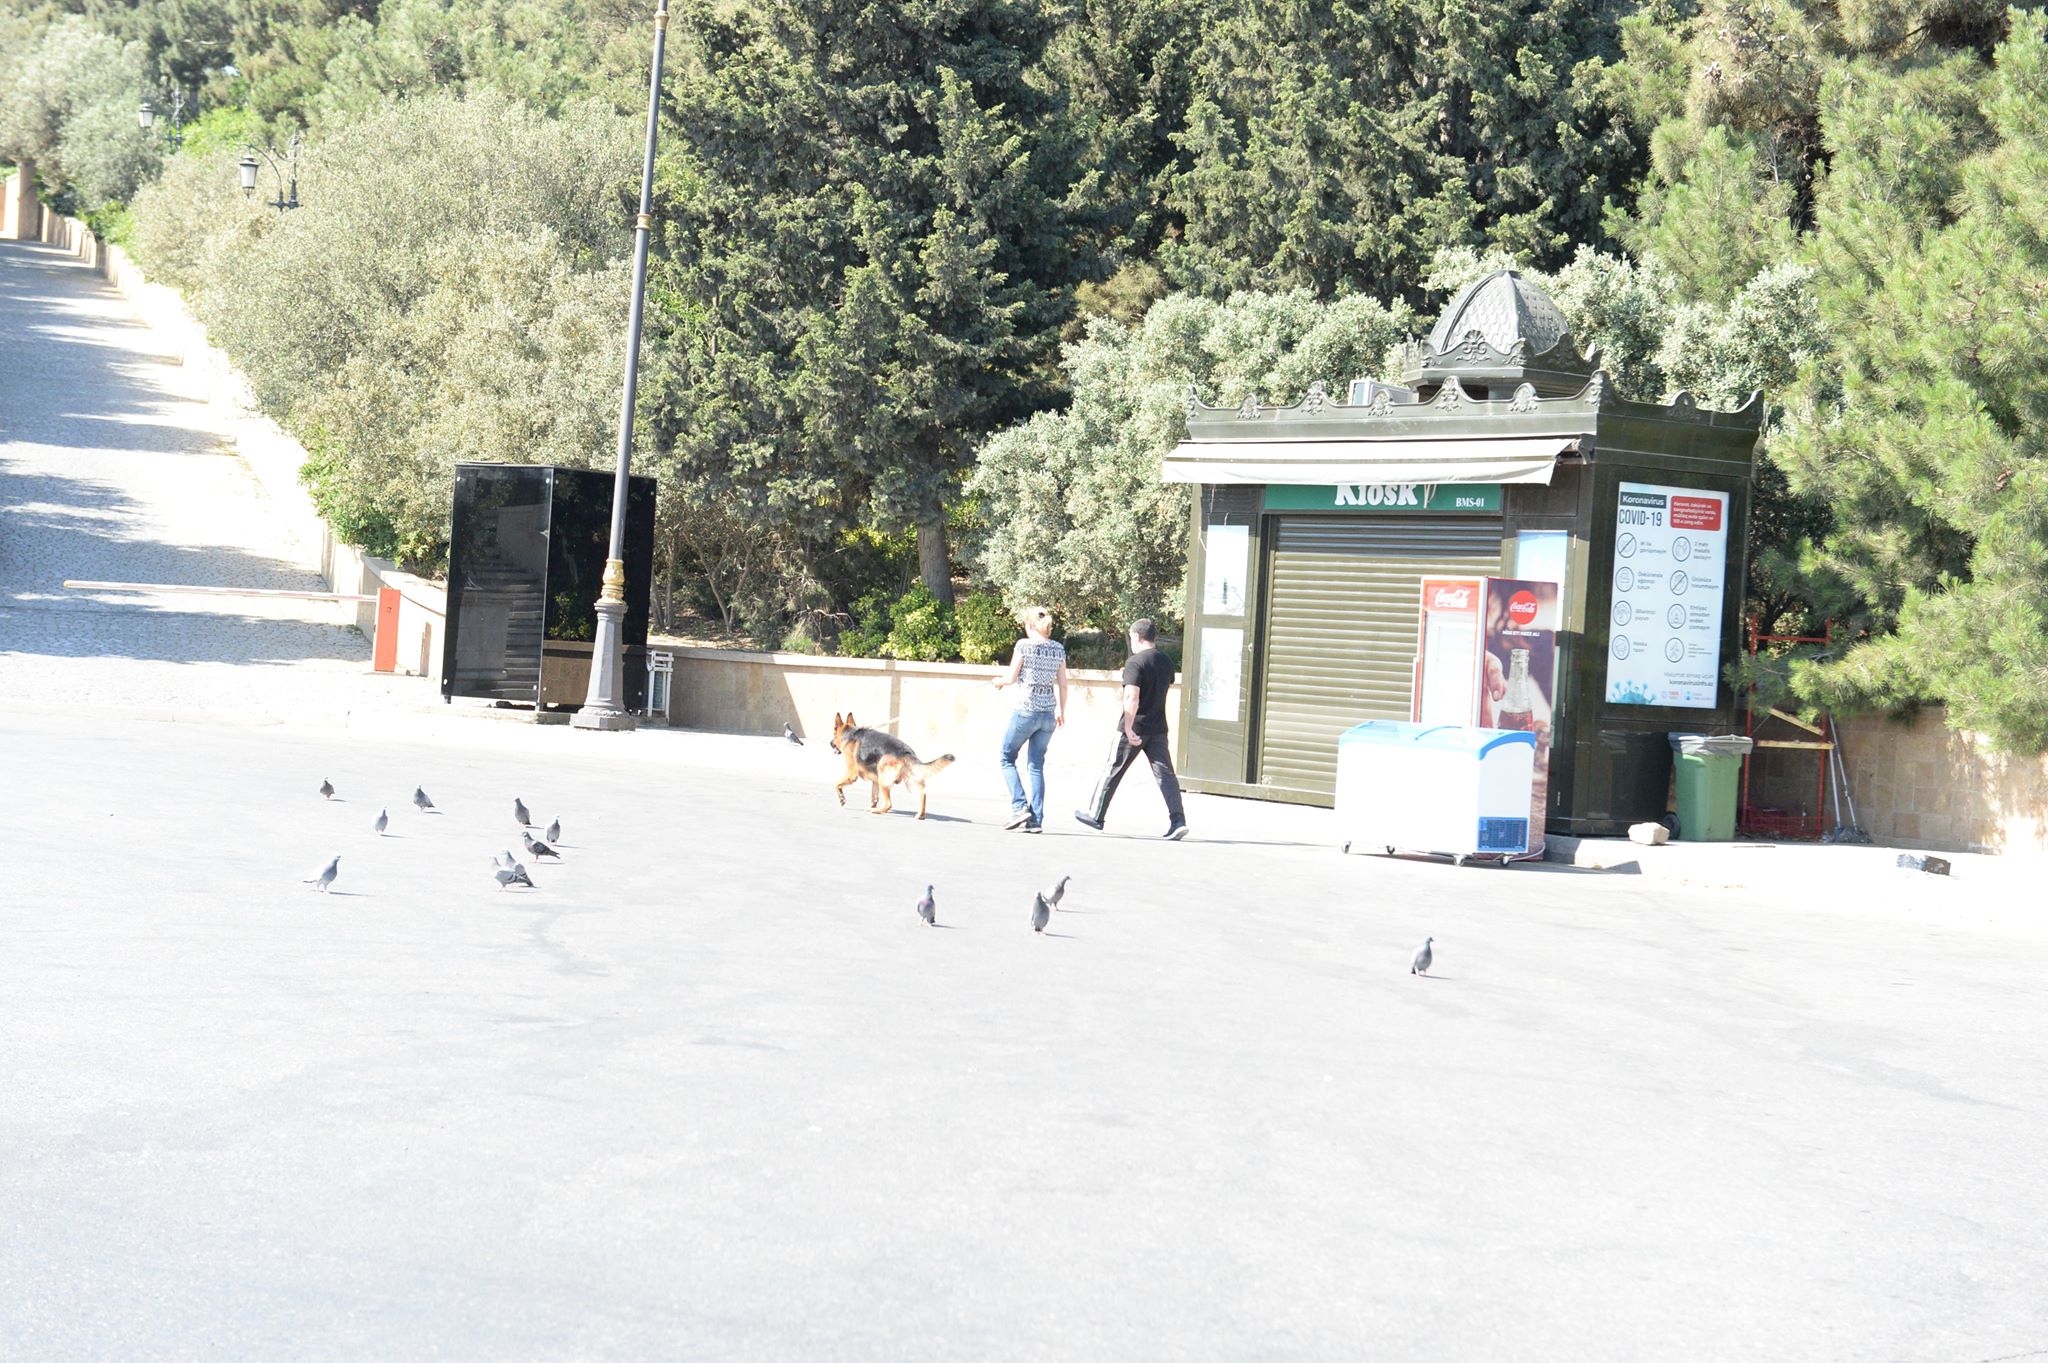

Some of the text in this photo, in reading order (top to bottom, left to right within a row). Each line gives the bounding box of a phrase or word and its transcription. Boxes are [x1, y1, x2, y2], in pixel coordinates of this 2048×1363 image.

[1455, 497, 1485, 508] BMS-01
[1622, 495, 1665, 506] Koronavirus
[1618, 509, 1662, 526] COVID-19
